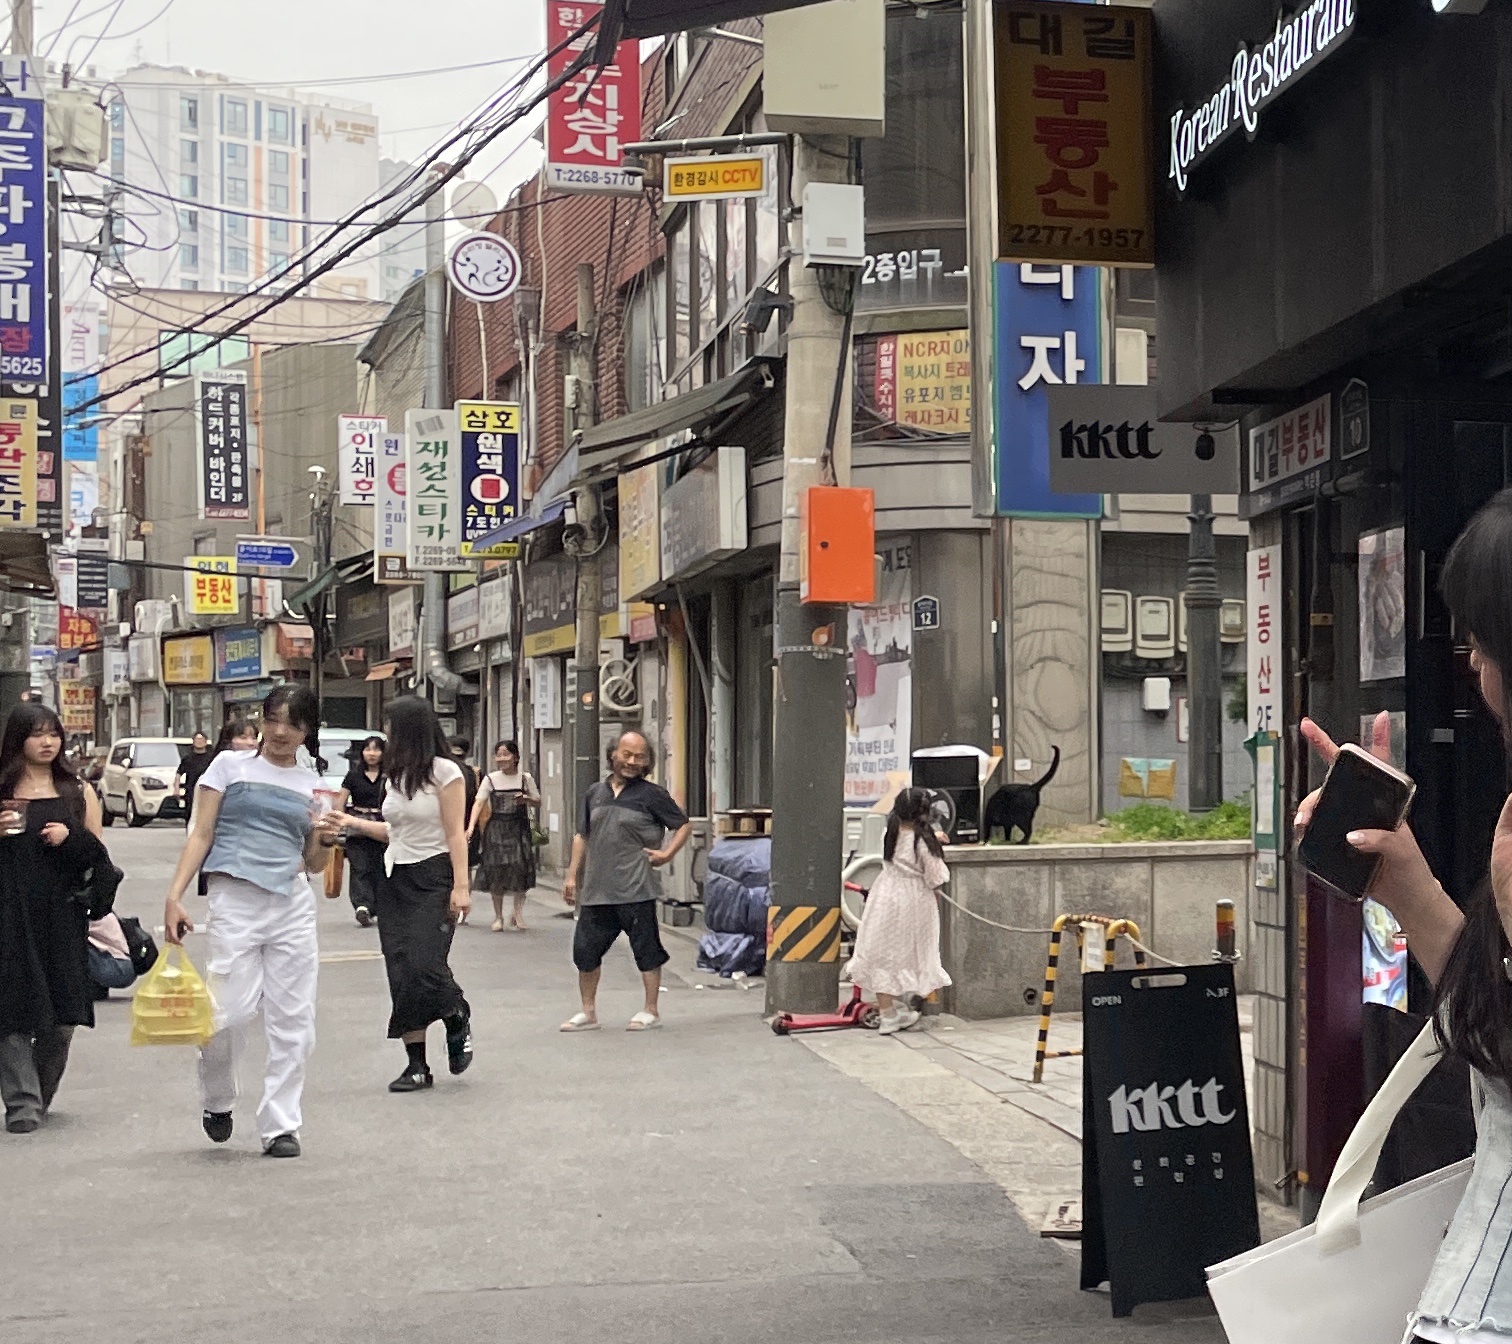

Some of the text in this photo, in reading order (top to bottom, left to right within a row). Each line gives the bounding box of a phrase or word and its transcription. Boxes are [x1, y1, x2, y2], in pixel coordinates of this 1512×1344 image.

[1008, 10, 1136, 60] 대길
[1032, 63, 1119, 220] 부동산
[1168, 82, 1231, 192] Korean
[554, 167, 636, 187] T:2268-5770
[721, 166, 759, 185] CCTV
[1009, 223, 1145, 249] 2277-1957
[861, 248, 943, 285] 2층입구
[903, 339, 951, 358] NCR지
[465, 410, 515, 430] 삼호
[1059, 417, 1163, 459] kktt
[476, 433, 503, 475] 원색
[415, 440, 451, 543] 재성스티카
[196, 577, 234, 605] 부동산
[919, 612, 932, 626] 12
[1256, 554, 1273, 695] 부동산
[1091, 995, 1122, 1007] OPEN
[1107, 1076, 1237, 1134] kktt
